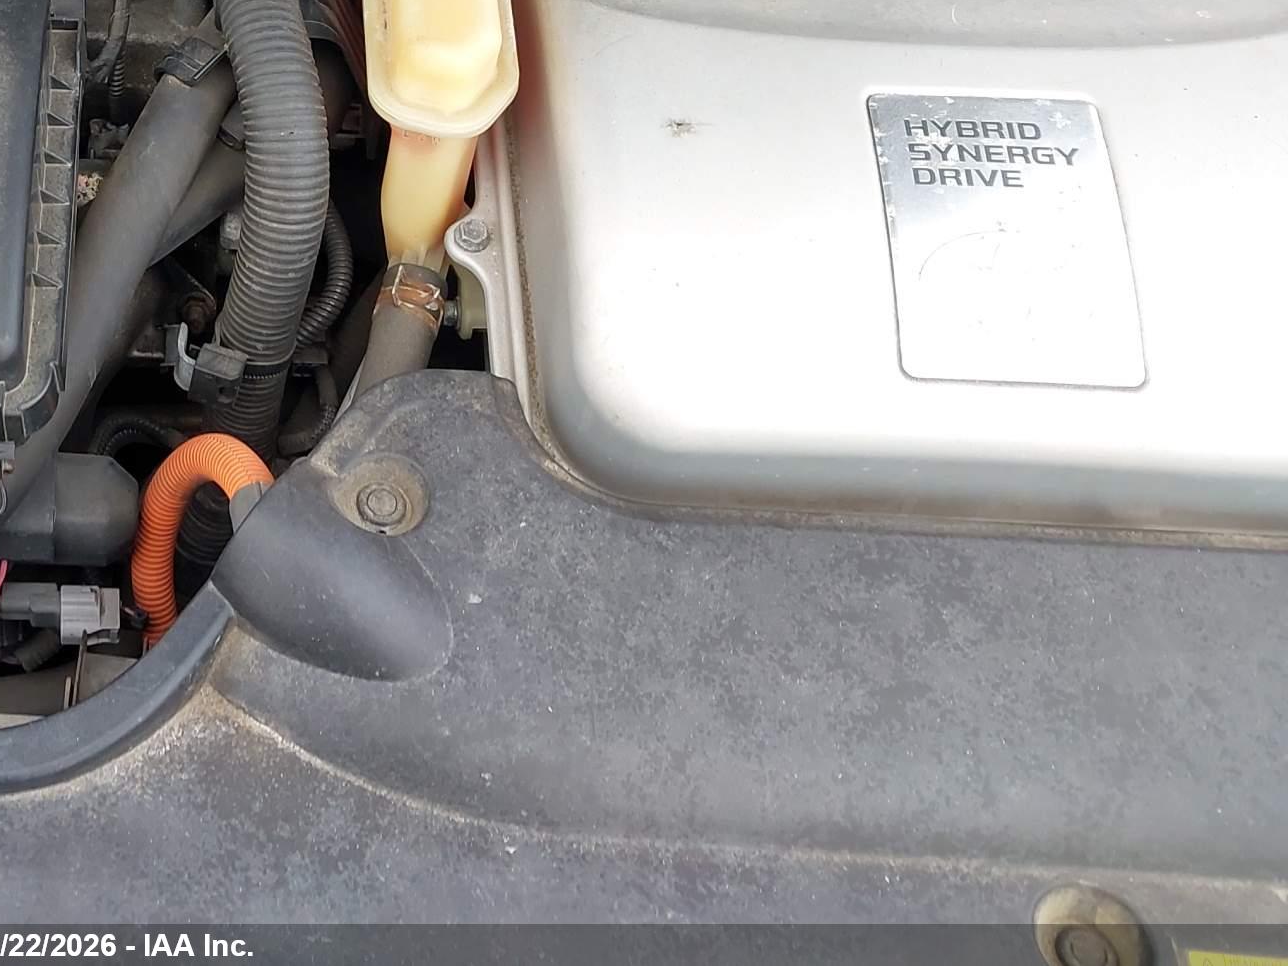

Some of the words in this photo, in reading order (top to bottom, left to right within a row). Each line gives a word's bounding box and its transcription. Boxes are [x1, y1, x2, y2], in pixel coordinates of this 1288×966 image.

[903, 119, 1042, 140] HYBRID
[907, 143, 1079, 166] SYNERGY
[912, 167, 1025, 188] DRIVE
